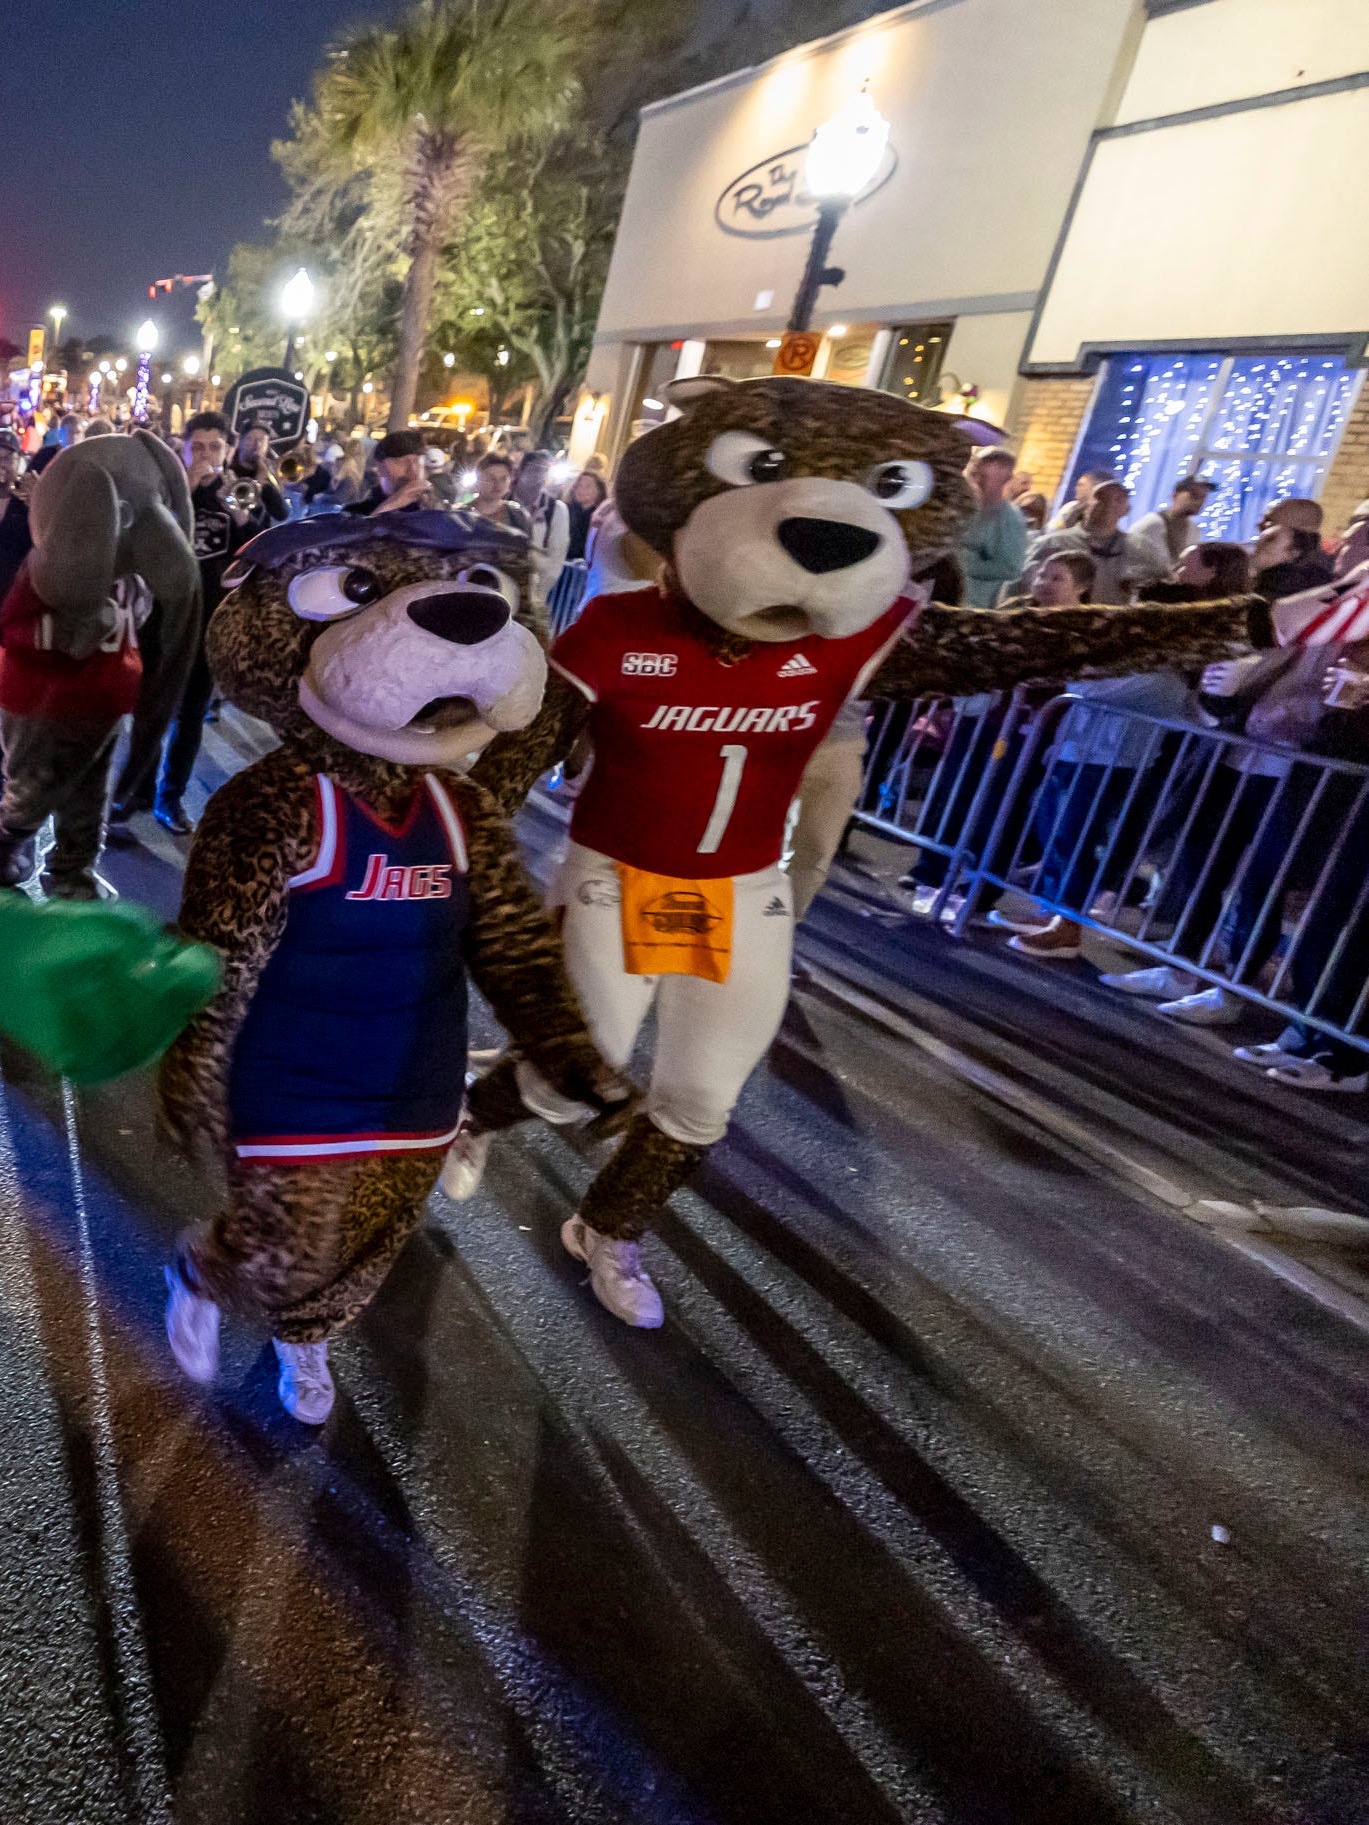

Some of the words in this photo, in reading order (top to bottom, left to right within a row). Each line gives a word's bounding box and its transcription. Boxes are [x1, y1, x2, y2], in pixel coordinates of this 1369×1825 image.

[621, 652, 679, 677] SBC
[639, 700, 821, 733] JAGUARS
[696, 744, 748, 854] 1
